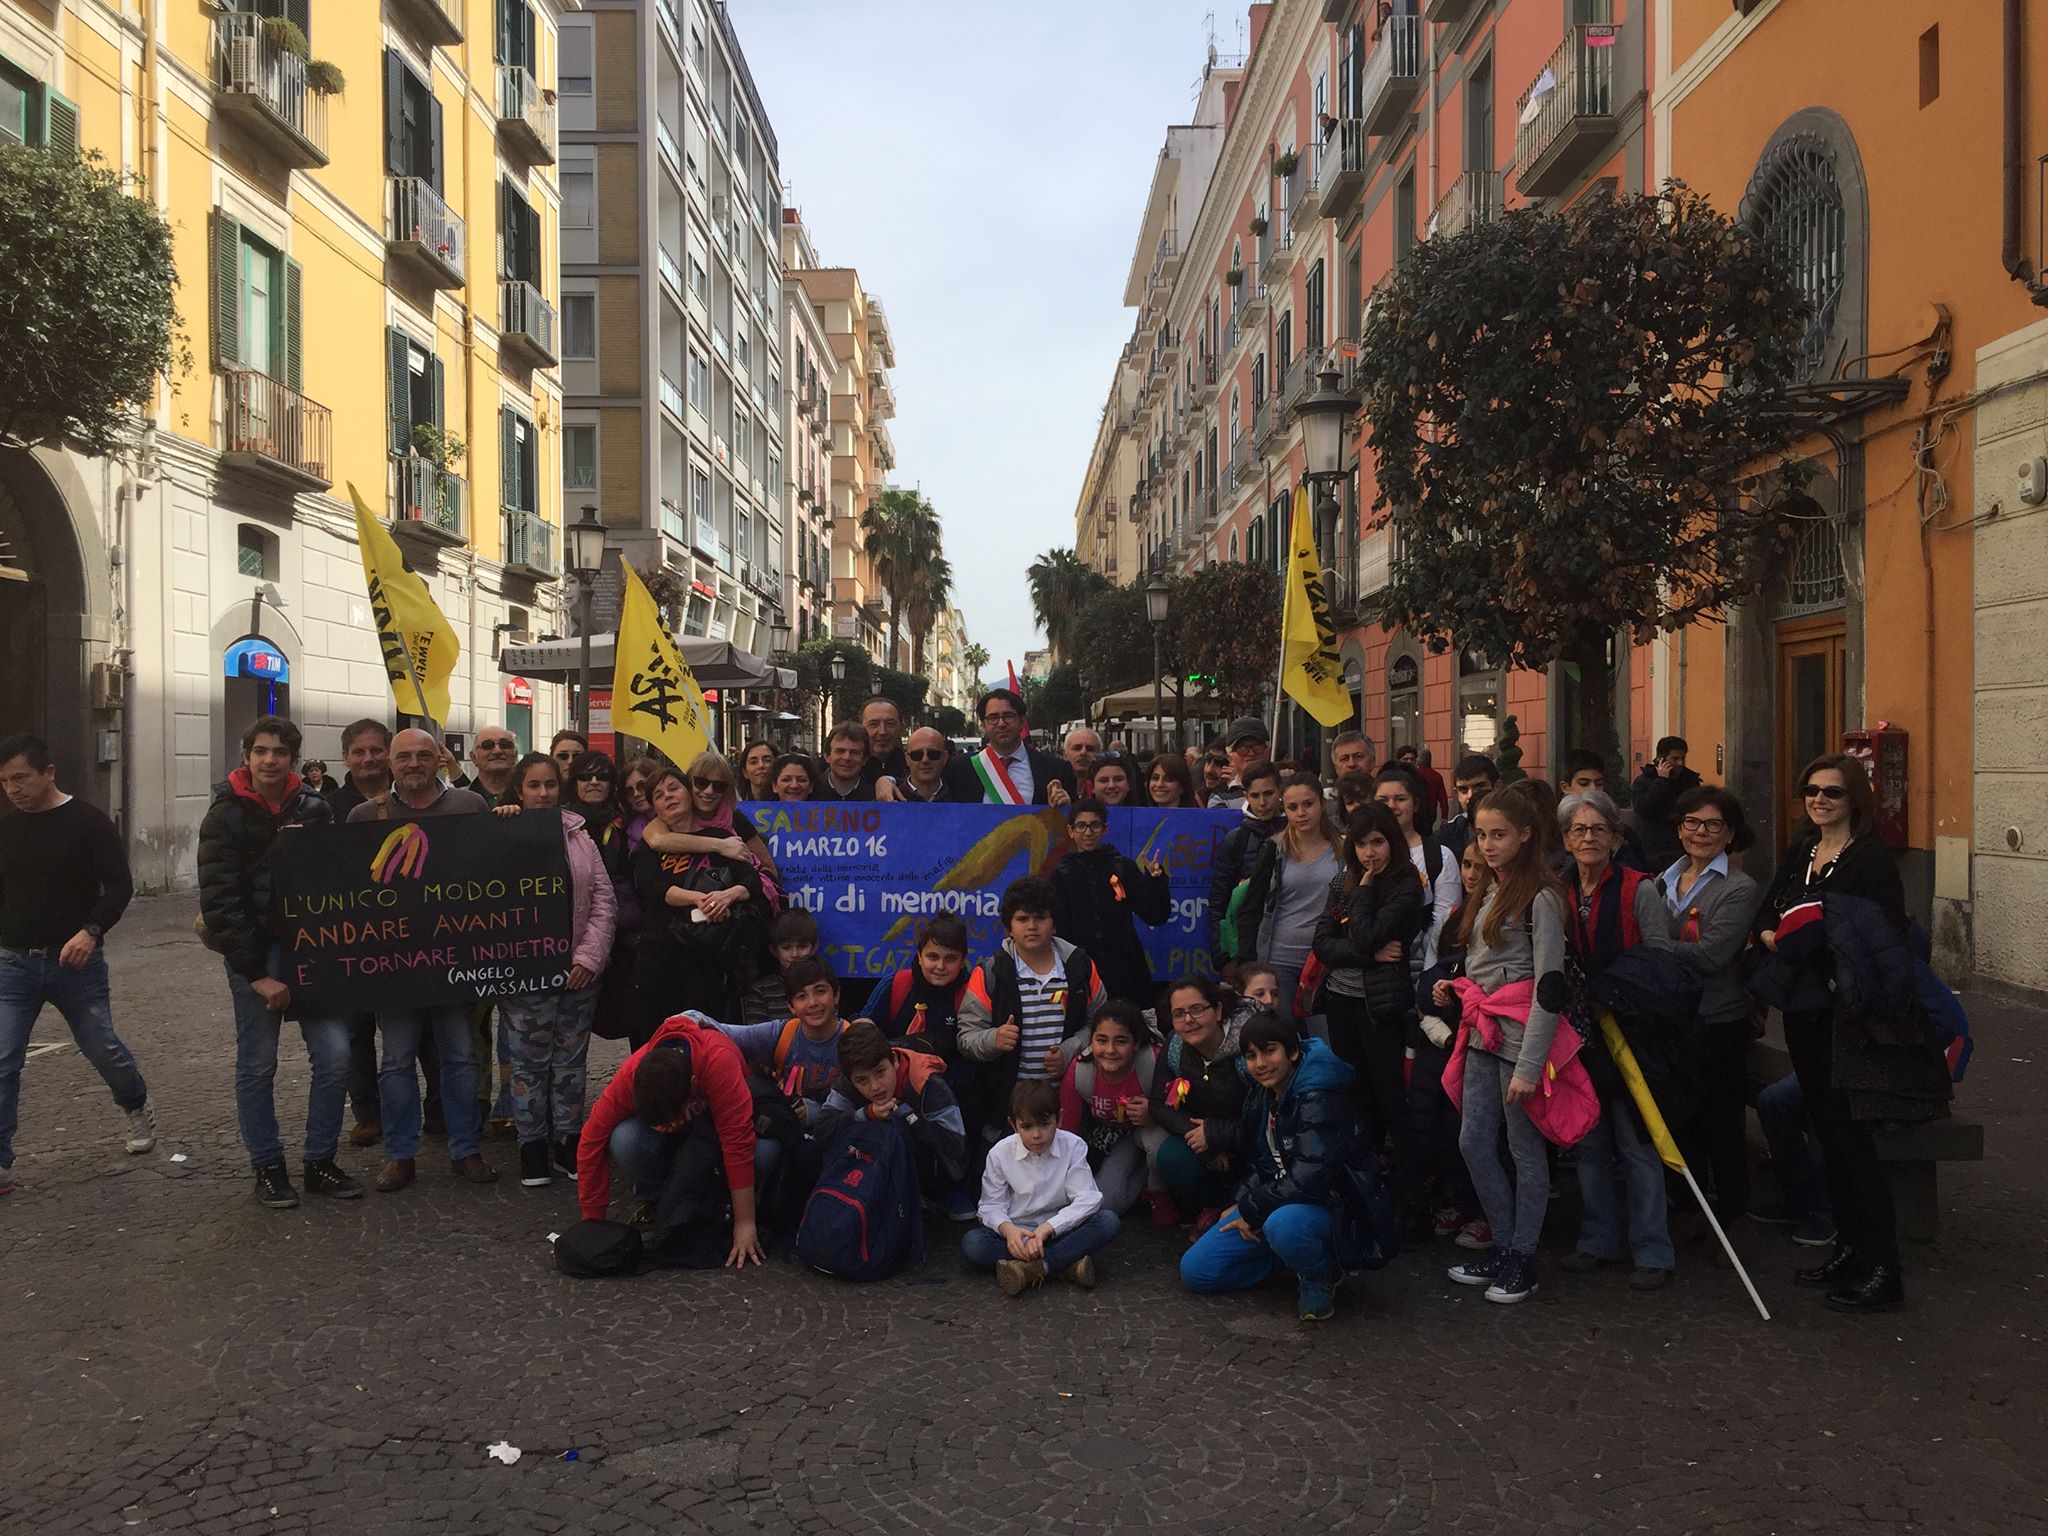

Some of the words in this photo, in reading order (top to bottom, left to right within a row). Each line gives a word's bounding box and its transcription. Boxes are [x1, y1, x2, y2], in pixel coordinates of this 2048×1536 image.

[267, 656, 281, 672] TIM
[755, 807, 882, 833] SALERNO
[786, 836, 860, 858] MARZO
[865, 834, 887, 857] 16
[284, 888, 398, 918] L'UNICO
[424, 879, 506, 903] MODO
[519, 876, 566, 897] PER
[835, 883, 866, 912] di
[881, 889, 1000, 916] memoria
[294, 916, 410, 951] ANDARE
[433, 906, 538, 937] AVANTI
[338, 946, 459, 977] TORNARE
[472, 936, 570, 962] INDIETRO
